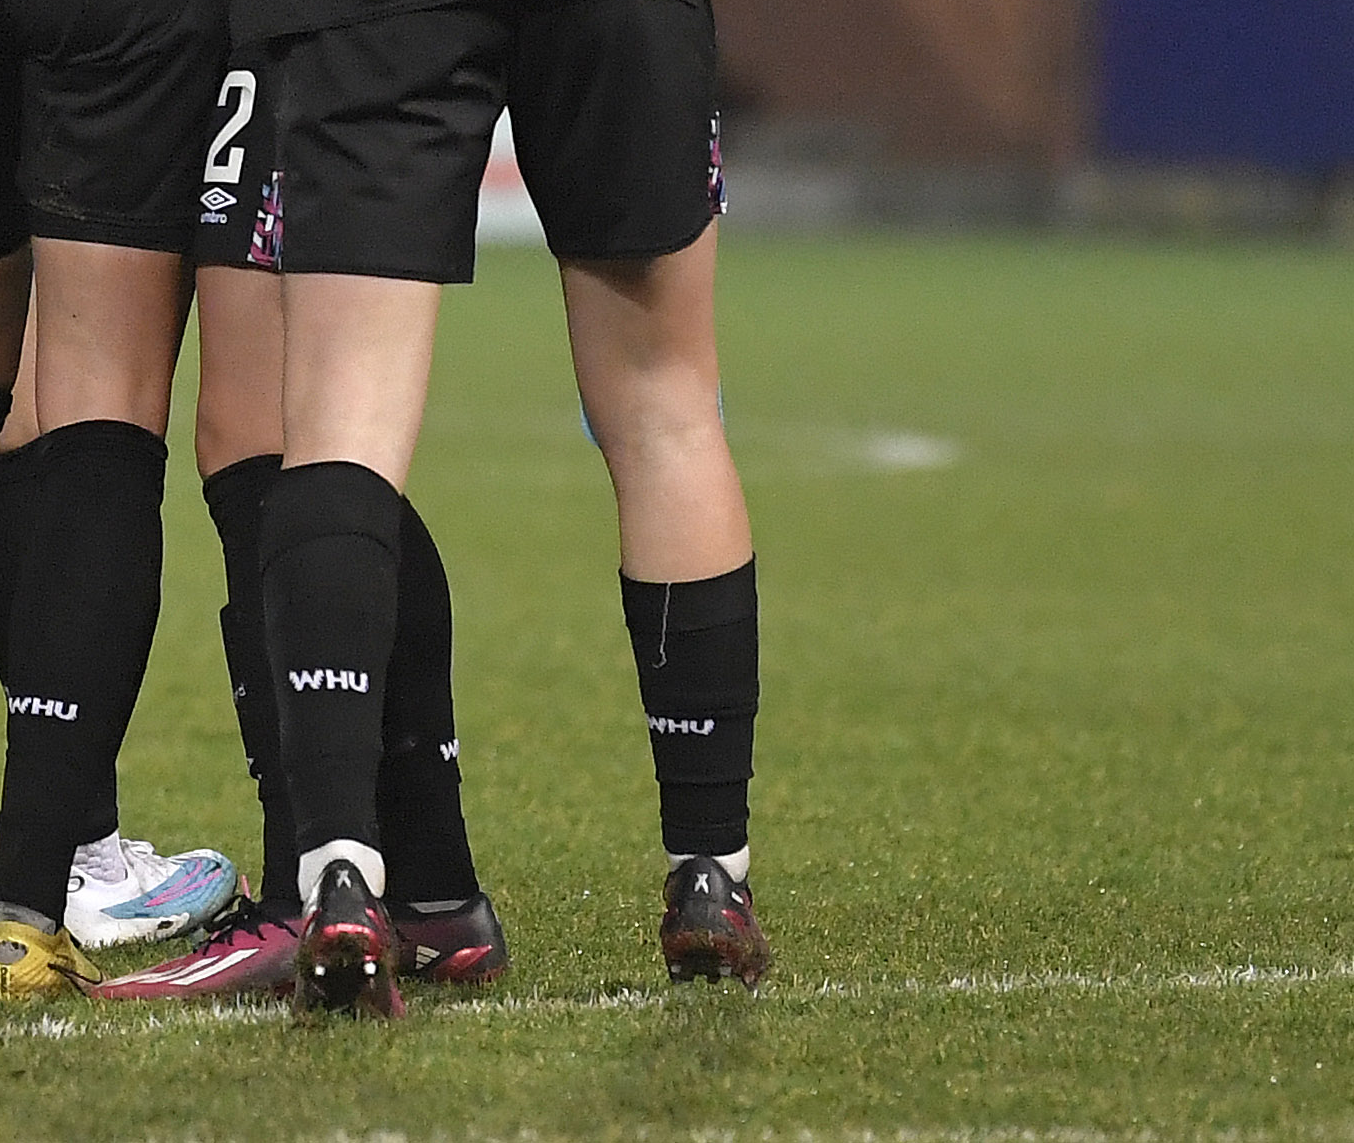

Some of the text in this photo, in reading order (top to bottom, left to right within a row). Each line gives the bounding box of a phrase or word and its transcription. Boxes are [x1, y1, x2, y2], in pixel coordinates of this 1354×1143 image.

[203, 70, 257, 184] 2
[289, 668, 370, 693] WHU
[8, 696, 79, 721] WHU
[645, 713, 715, 736] WHU
